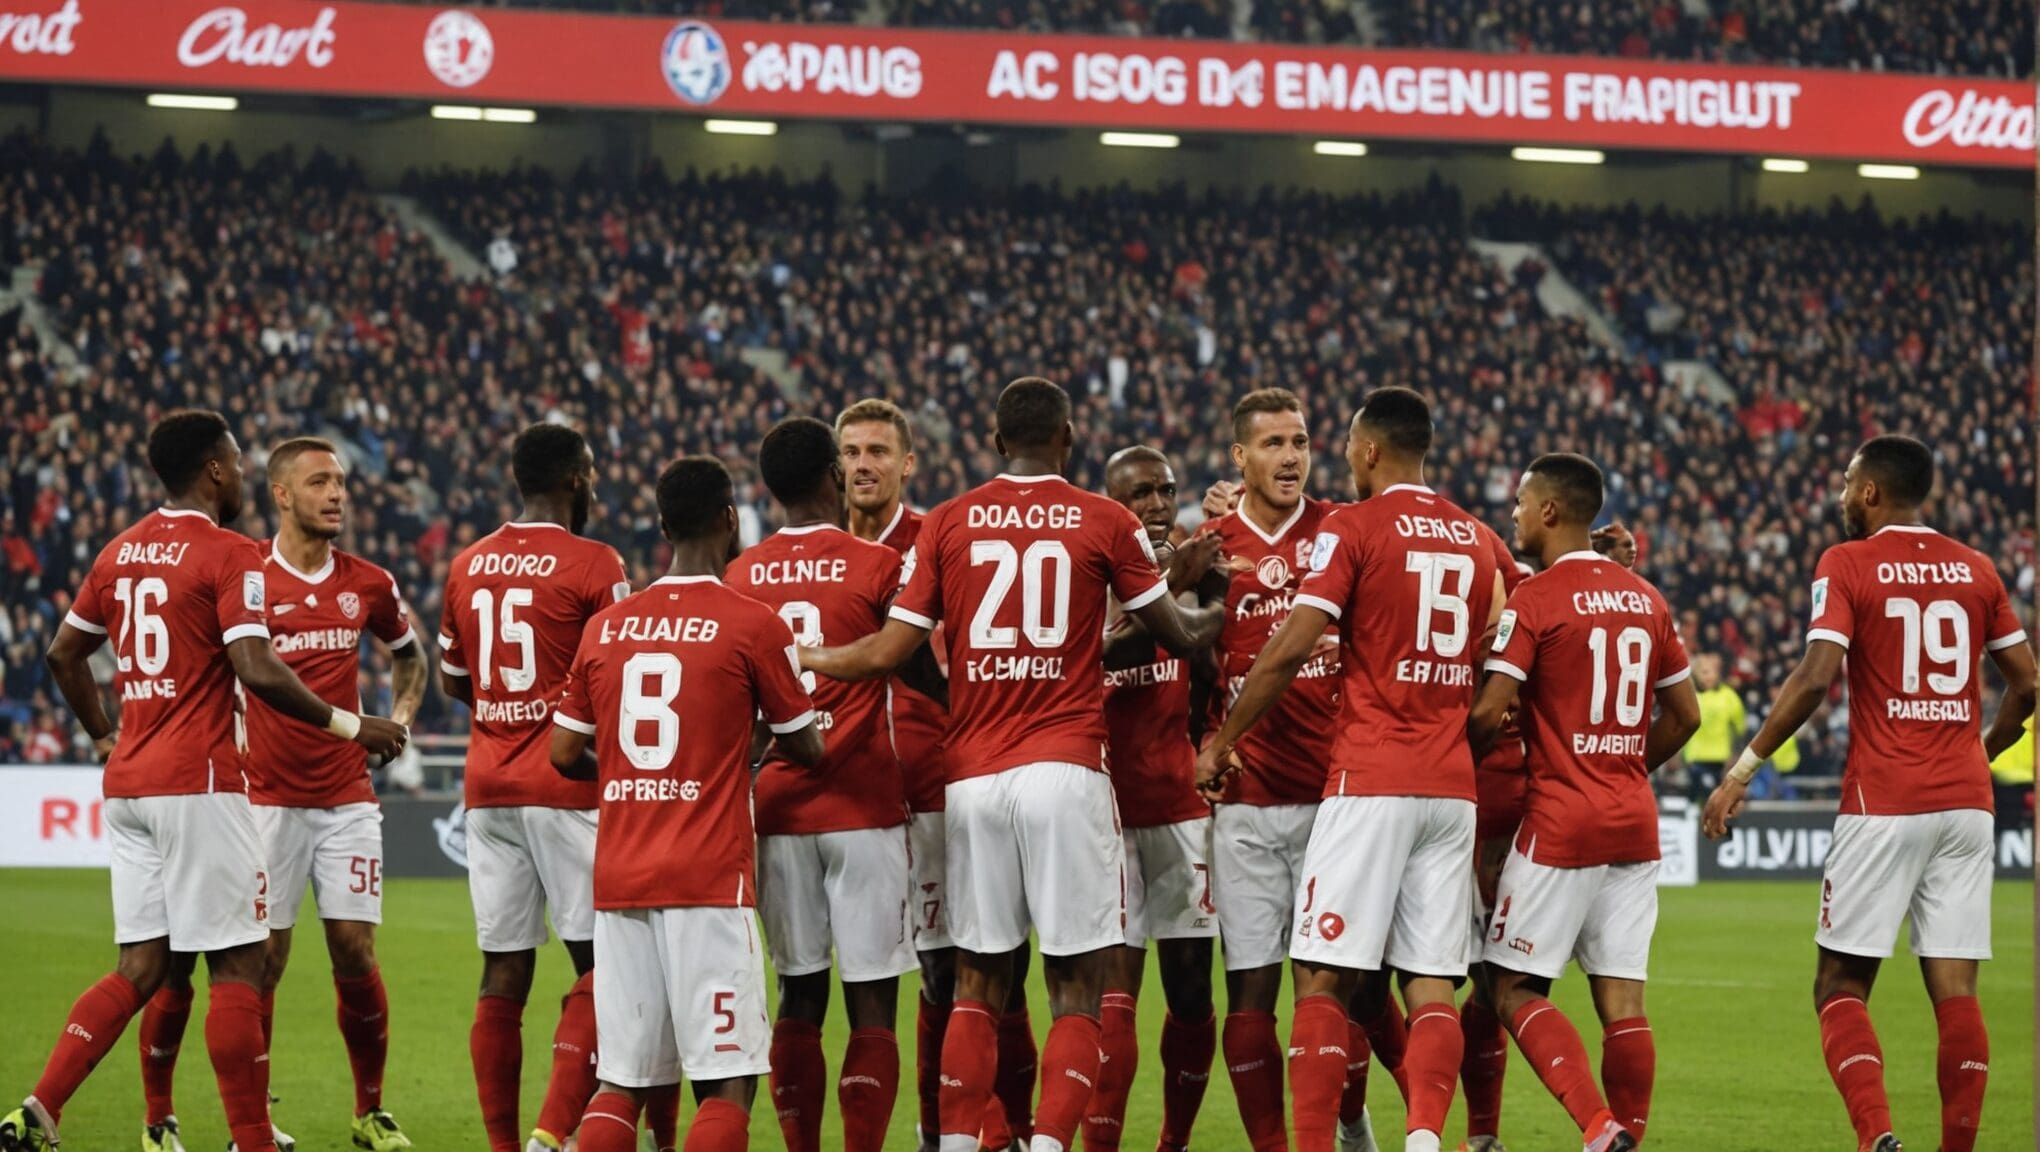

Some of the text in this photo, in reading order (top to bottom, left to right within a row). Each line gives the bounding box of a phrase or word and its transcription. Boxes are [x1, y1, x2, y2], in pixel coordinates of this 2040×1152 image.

[986, 50, 1061, 101] AC
[1072, 52, 1188, 106] ISOG
[471, 587, 537, 693] 15
[969, 539, 1072, 649] 20
[1588, 626, 1653, 727] 18
[1885, 597, 1971, 695] 19
[618, 652, 683, 771] 8
[713, 991, 736, 1034] 5
